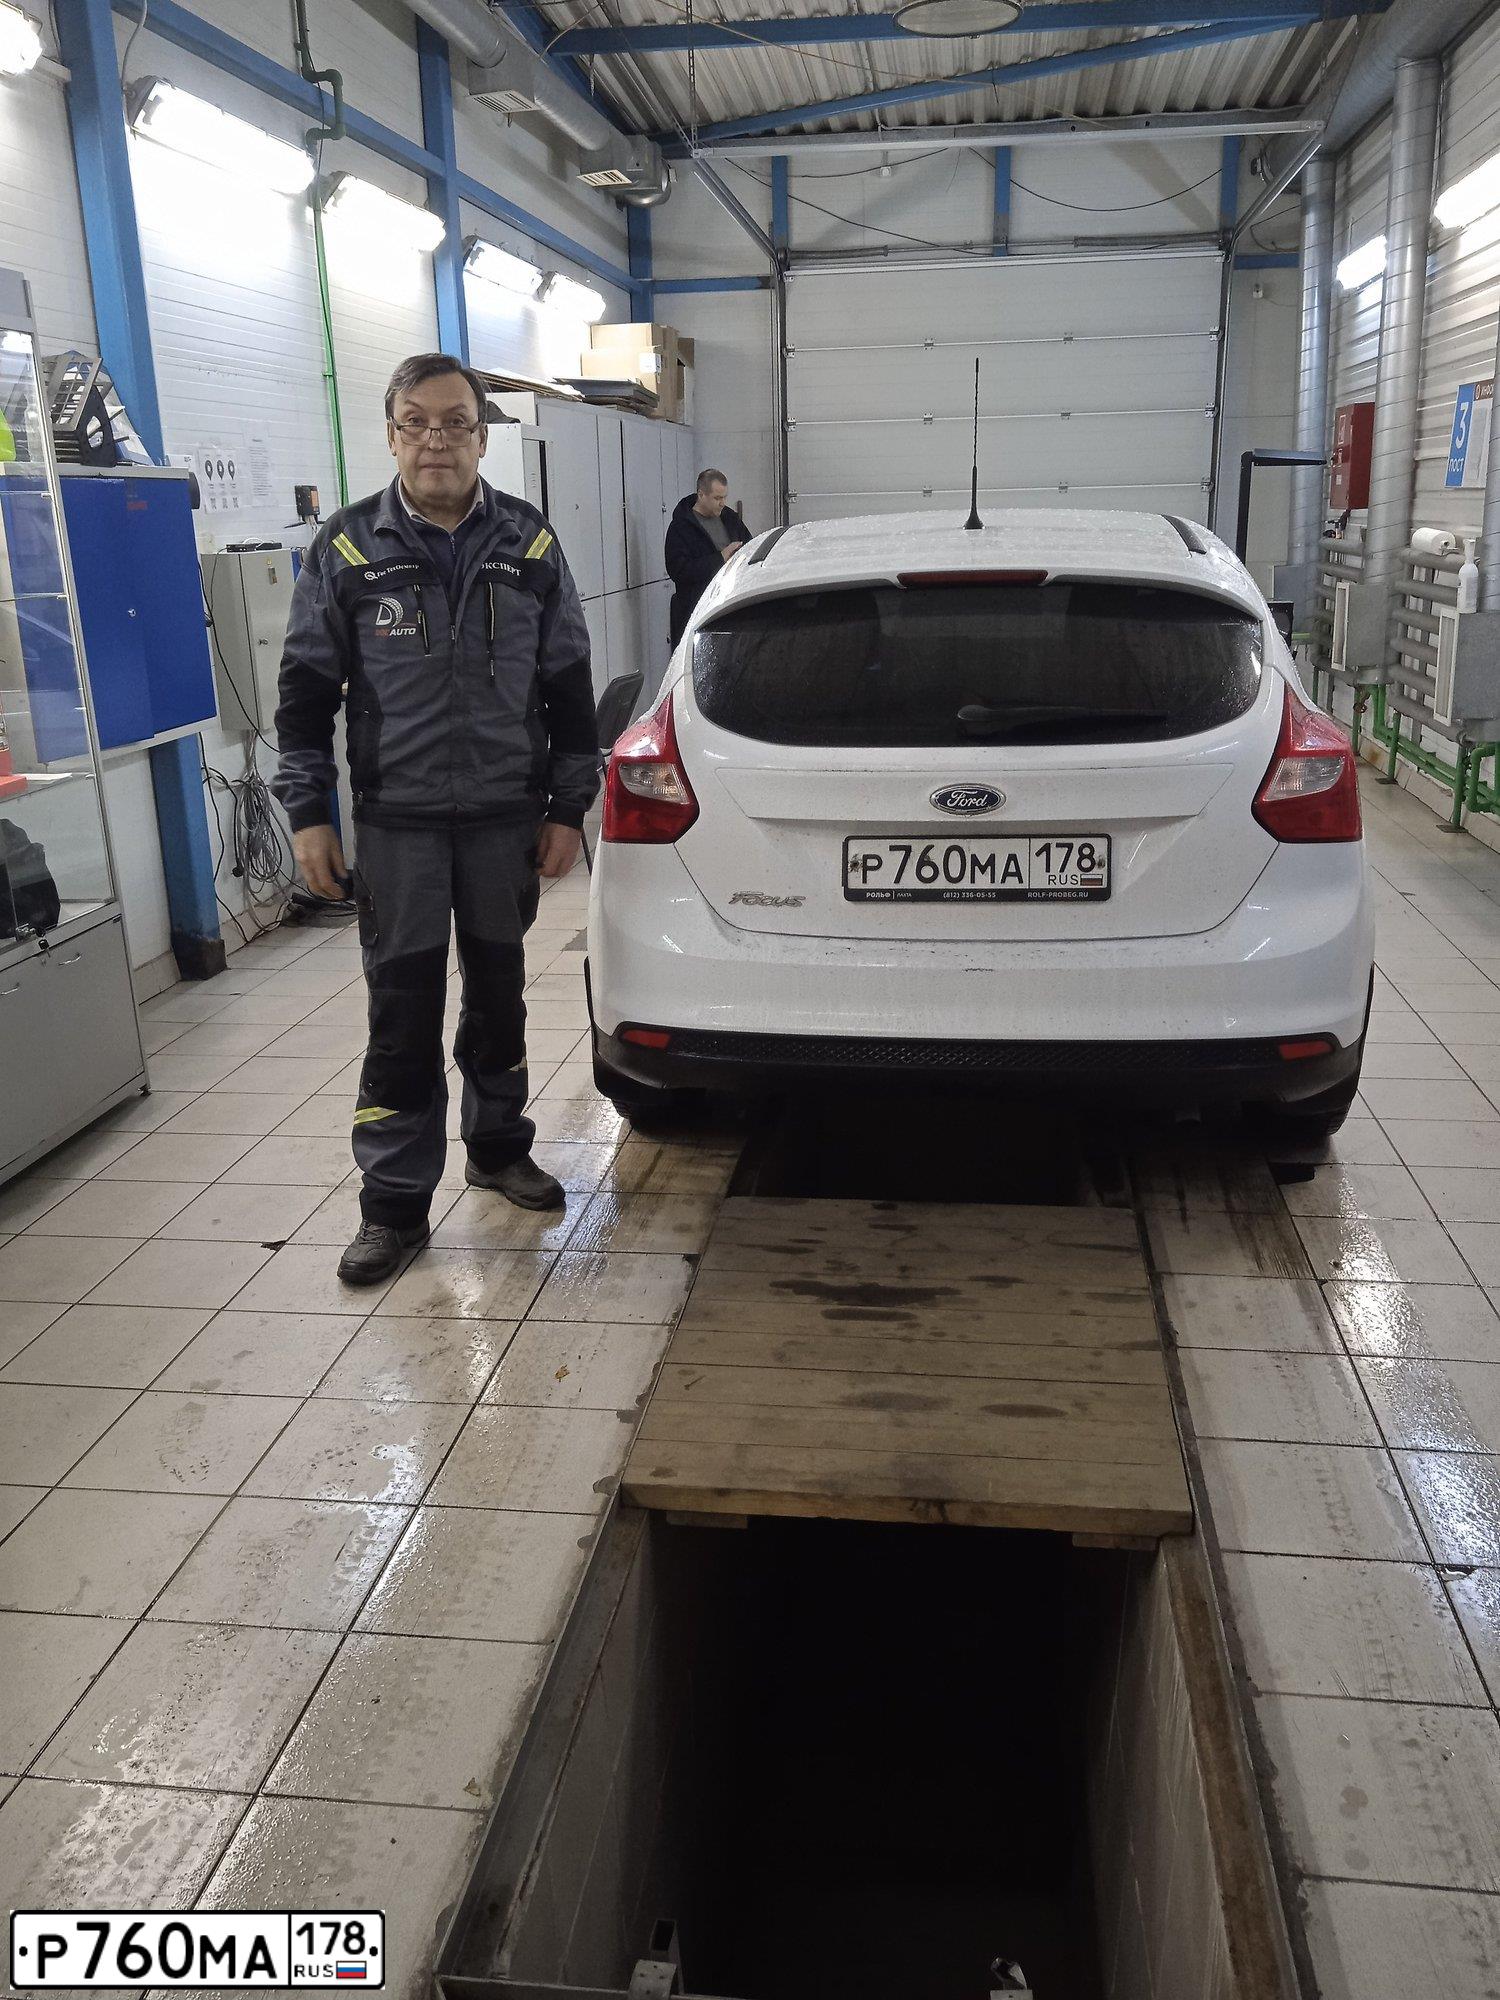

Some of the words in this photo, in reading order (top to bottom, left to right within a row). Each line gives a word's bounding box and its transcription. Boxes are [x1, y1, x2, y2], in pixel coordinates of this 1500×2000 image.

[1456, 401, 1469, 449] 3
[1449, 458, 1464, 472] ПОСТ
[946, 790, 988, 807] Ford
[1035, 842, 1096, 873] 178
[1047, 874, 1079, 885] RUS
